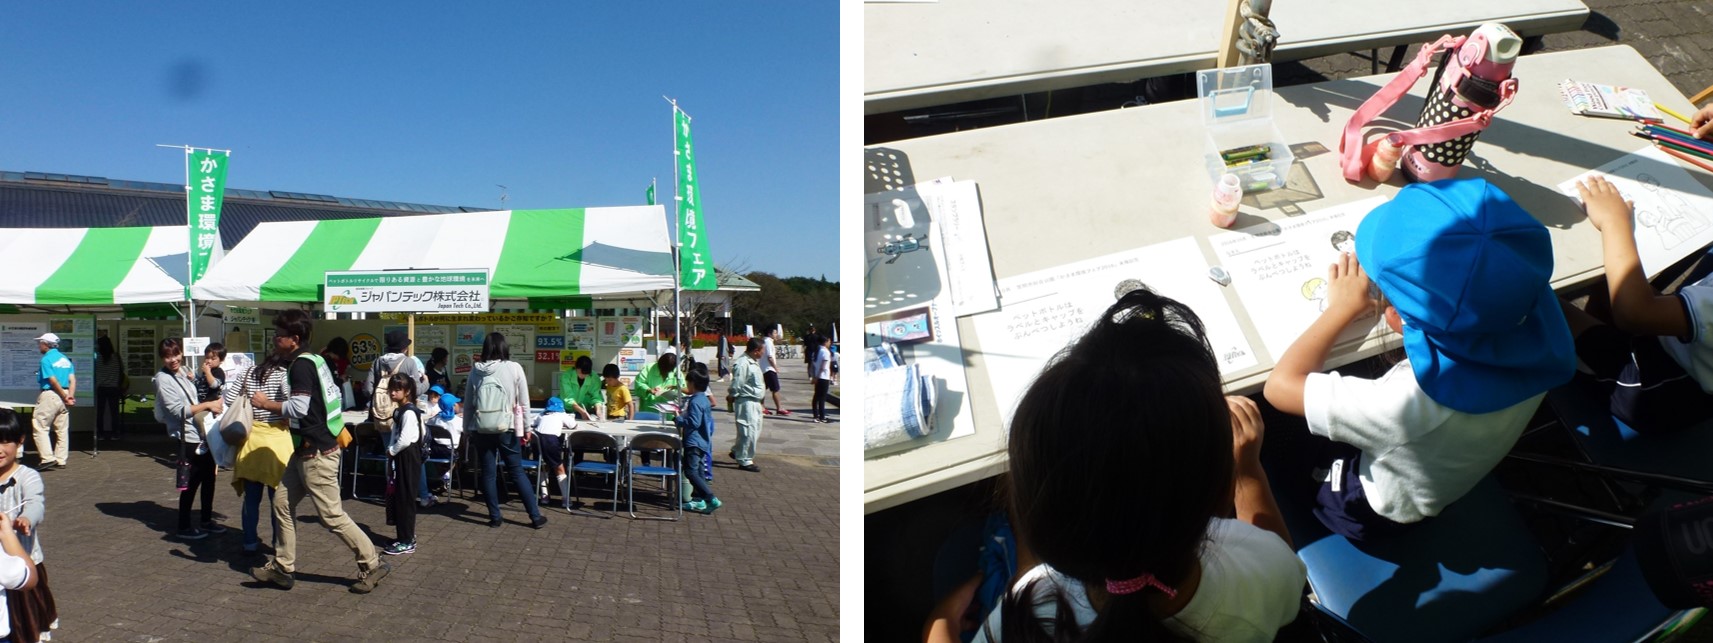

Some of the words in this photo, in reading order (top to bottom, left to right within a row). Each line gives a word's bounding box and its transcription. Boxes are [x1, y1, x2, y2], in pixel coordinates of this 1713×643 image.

[197, 157, 218, 277] かさま環境
[361, 290, 481, 303] ジャパンテック株式会社
[1012, 302, 1073, 321] ペットボトルは
[1007, 308, 1084, 333] ラベルとキャップを
[352, 340, 377, 354] 63%
[537, 337, 563, 346] 93.5%
